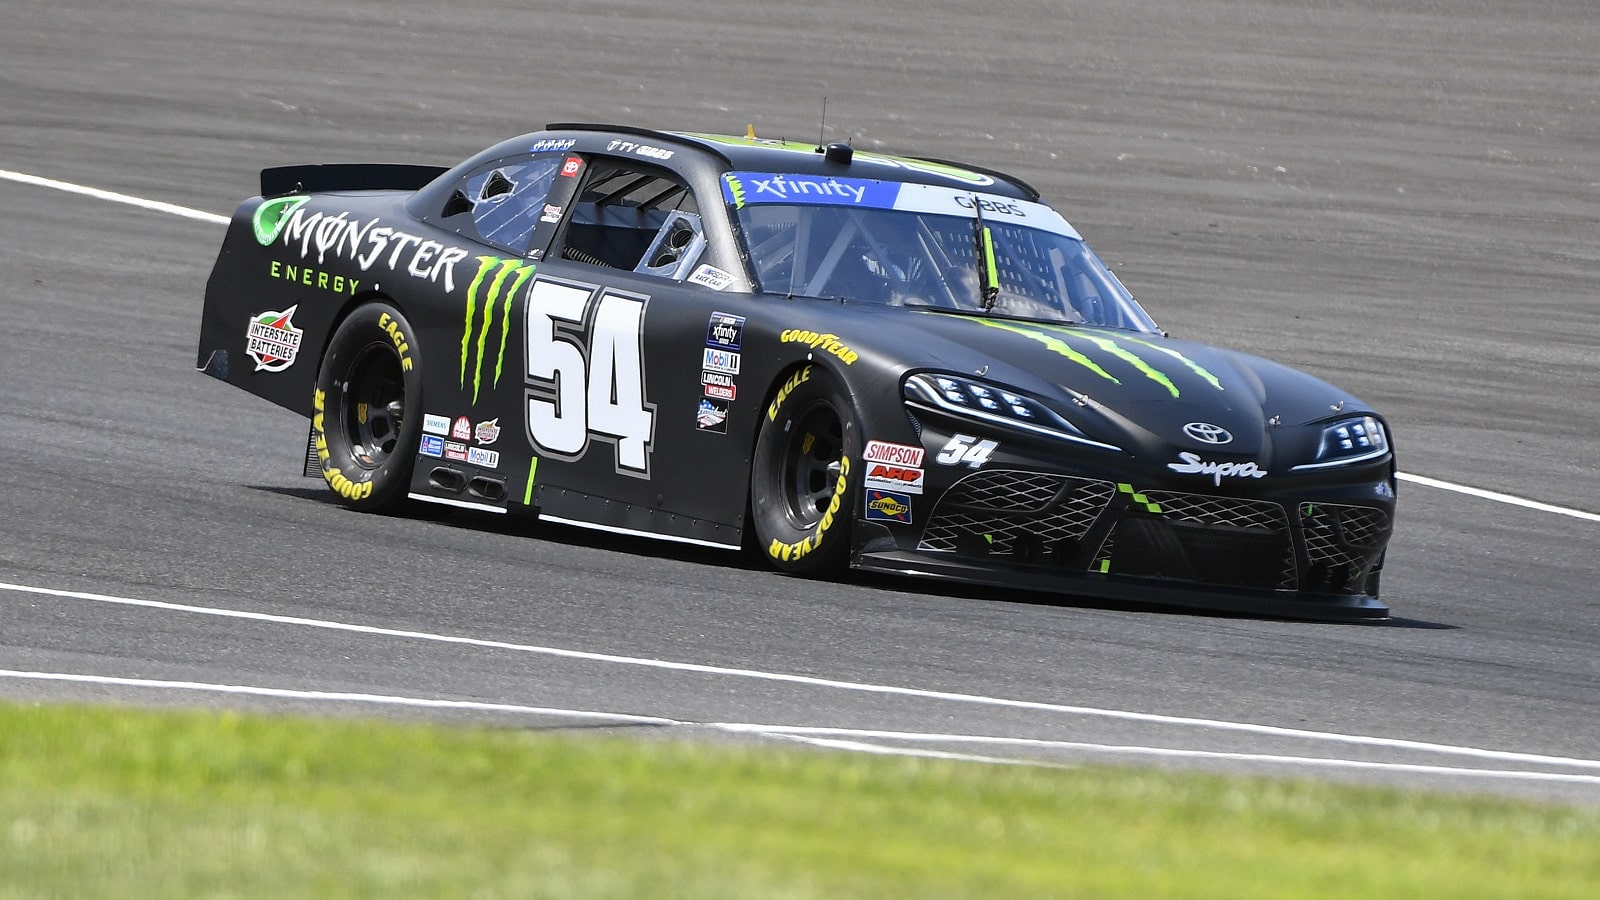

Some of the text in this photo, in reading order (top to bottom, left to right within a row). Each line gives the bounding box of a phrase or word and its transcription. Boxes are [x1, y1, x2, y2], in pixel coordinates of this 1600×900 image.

[619, 141, 640, 153] TY
[751, 176, 866, 204] xfinity
[270, 260, 360, 296] ENERGY
[251, 323, 299, 346] INTERSTATE
[378, 312, 413, 373] EAGLE
[712, 323, 738, 343] xfinity
[250, 338, 294, 361] BATTERIES
[705, 350, 729, 368] Mobil
[780, 329, 859, 366] GOODYEAR
[524, 273, 658, 481] 54
[703, 373, 731, 386] LINCOLN
[768, 364, 813, 422] EAGLE
[427, 420, 446, 429] SIEMENS
[313, 388, 373, 501] GOODYEAR
[470, 448, 489, 463] Mobil
[868, 444, 920, 465] SIMPSON
[936, 433, 998, 469] 54
[868, 464, 921, 482] ARP
[1167, 451, 1268, 487] Supra
[769, 455, 850, 562] GOODYEAR
[871, 501, 907, 513] SUNOCO
